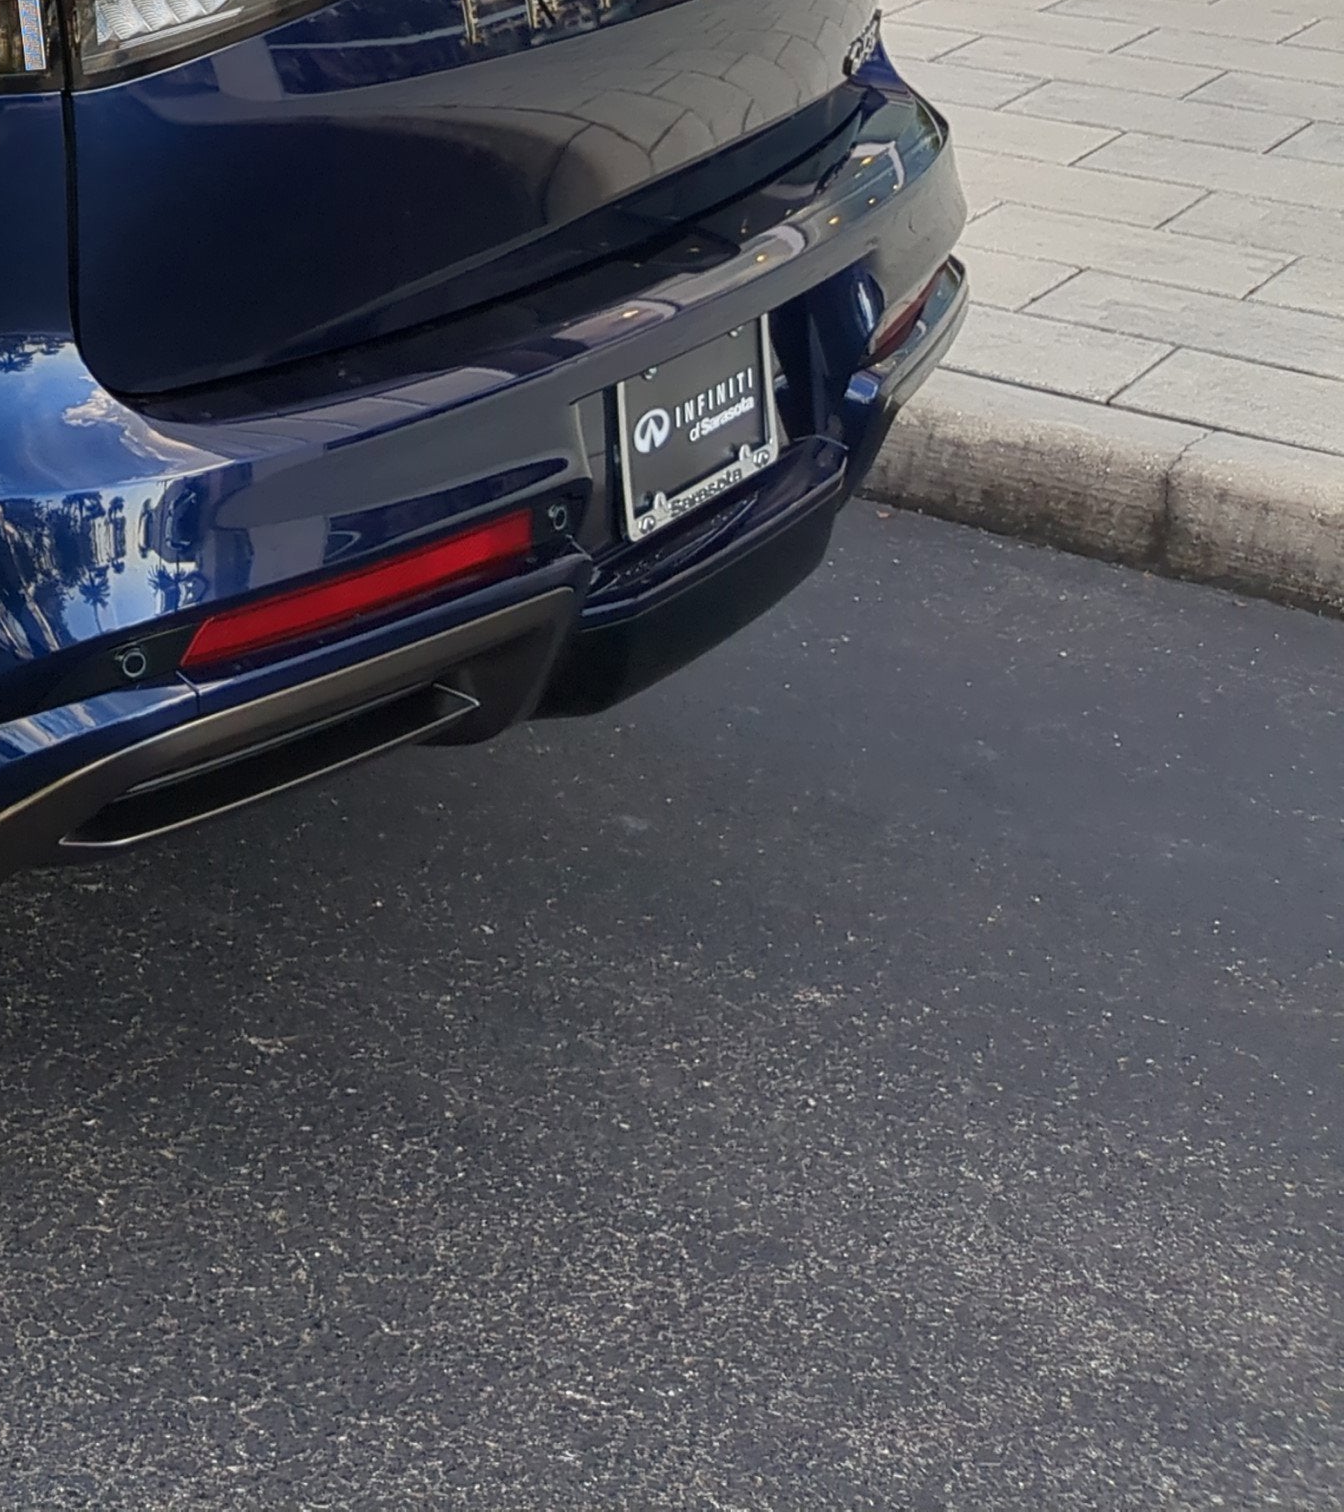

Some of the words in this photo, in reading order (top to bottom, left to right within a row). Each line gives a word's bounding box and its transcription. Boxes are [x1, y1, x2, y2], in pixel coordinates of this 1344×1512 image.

[675, 367, 753, 428] INFINITI
[700, 396, 754, 435] Sarasota
[670, 468, 743, 516] Sarasota
